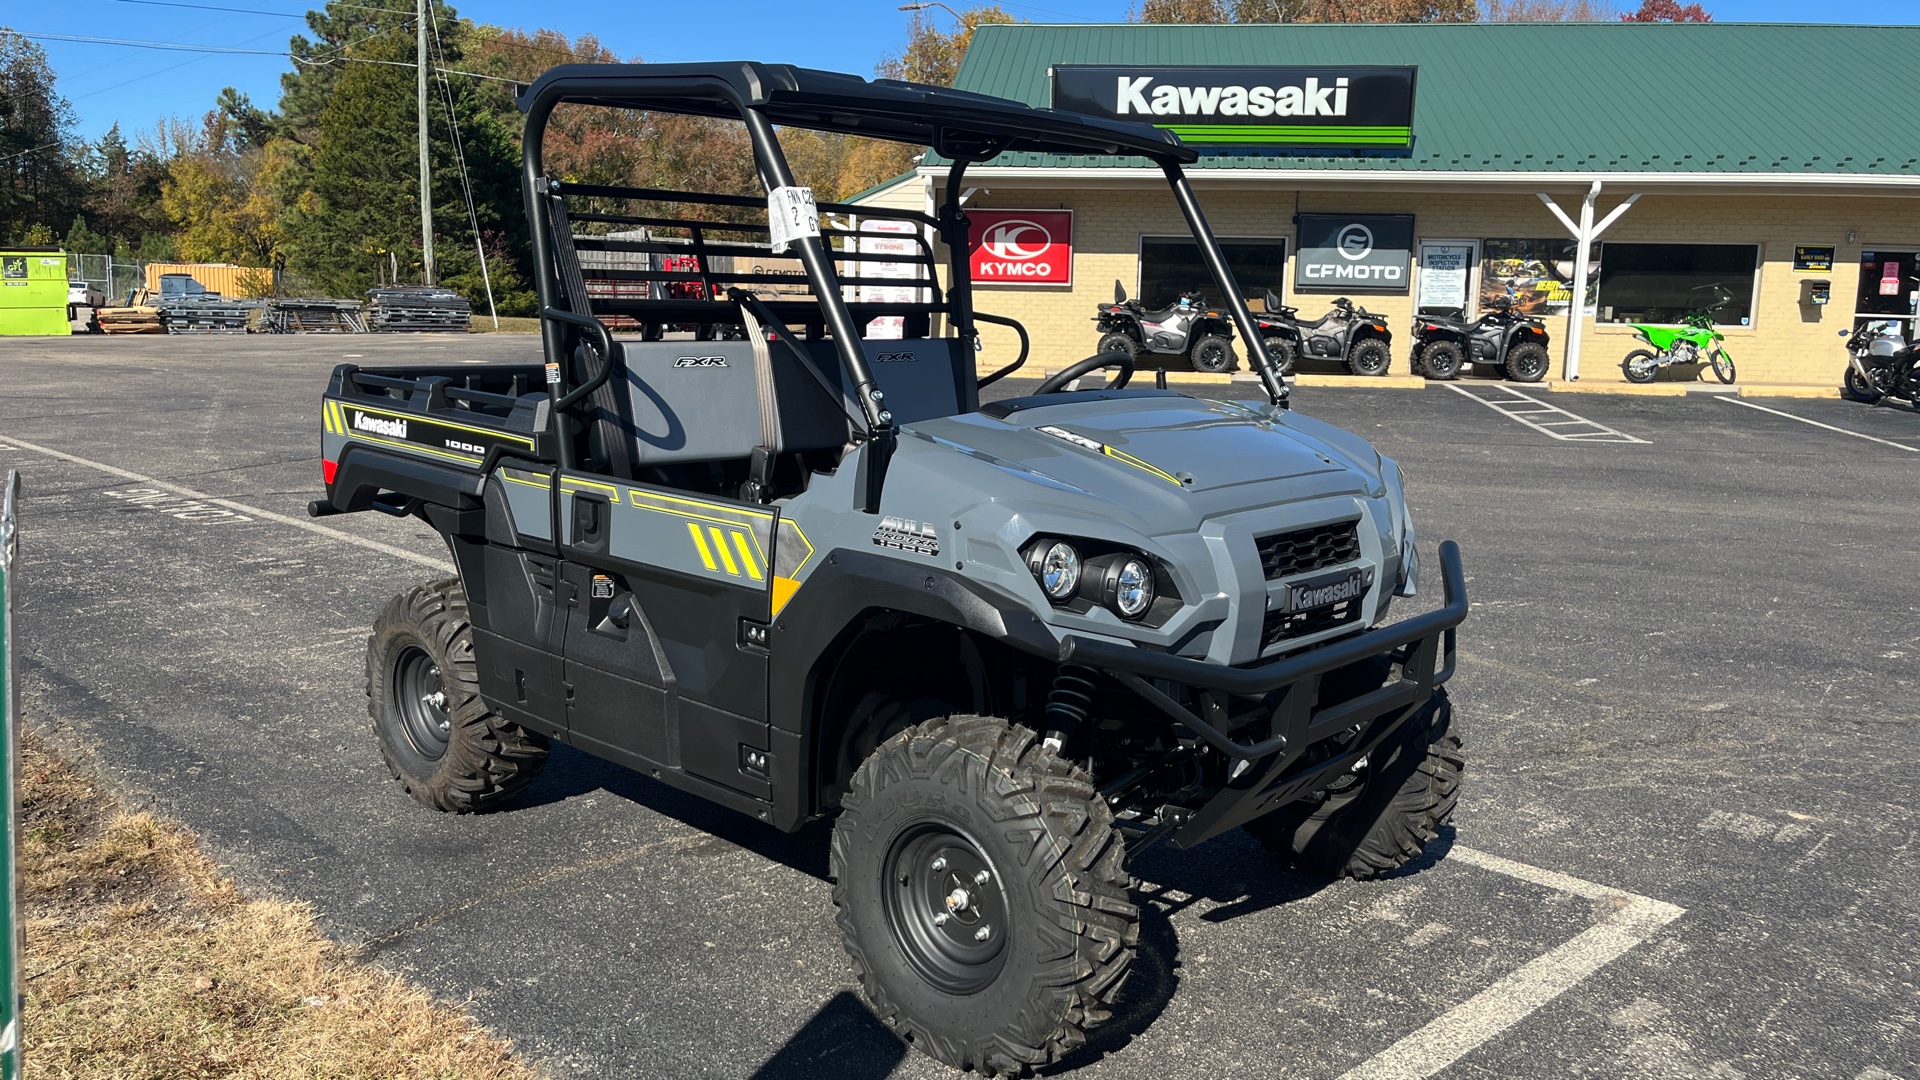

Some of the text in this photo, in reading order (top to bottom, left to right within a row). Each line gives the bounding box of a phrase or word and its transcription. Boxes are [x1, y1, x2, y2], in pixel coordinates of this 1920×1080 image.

[1117, 76, 1349, 117] Kawasaki
[874, 243, 904, 251] STRONG
[980, 262, 1051, 276] KYMCO
[1305, 263, 1401, 280] CFMOTO
[1535, 281, 1561, 290] READY
[673, 355, 731, 368] FXR
[875, 352, 918, 363] FXR
[354, 410, 486, 454] Kawasaki 1000
[876, 515, 938, 540] MULE
[1291, 573, 1361, 611] Kawasaki
